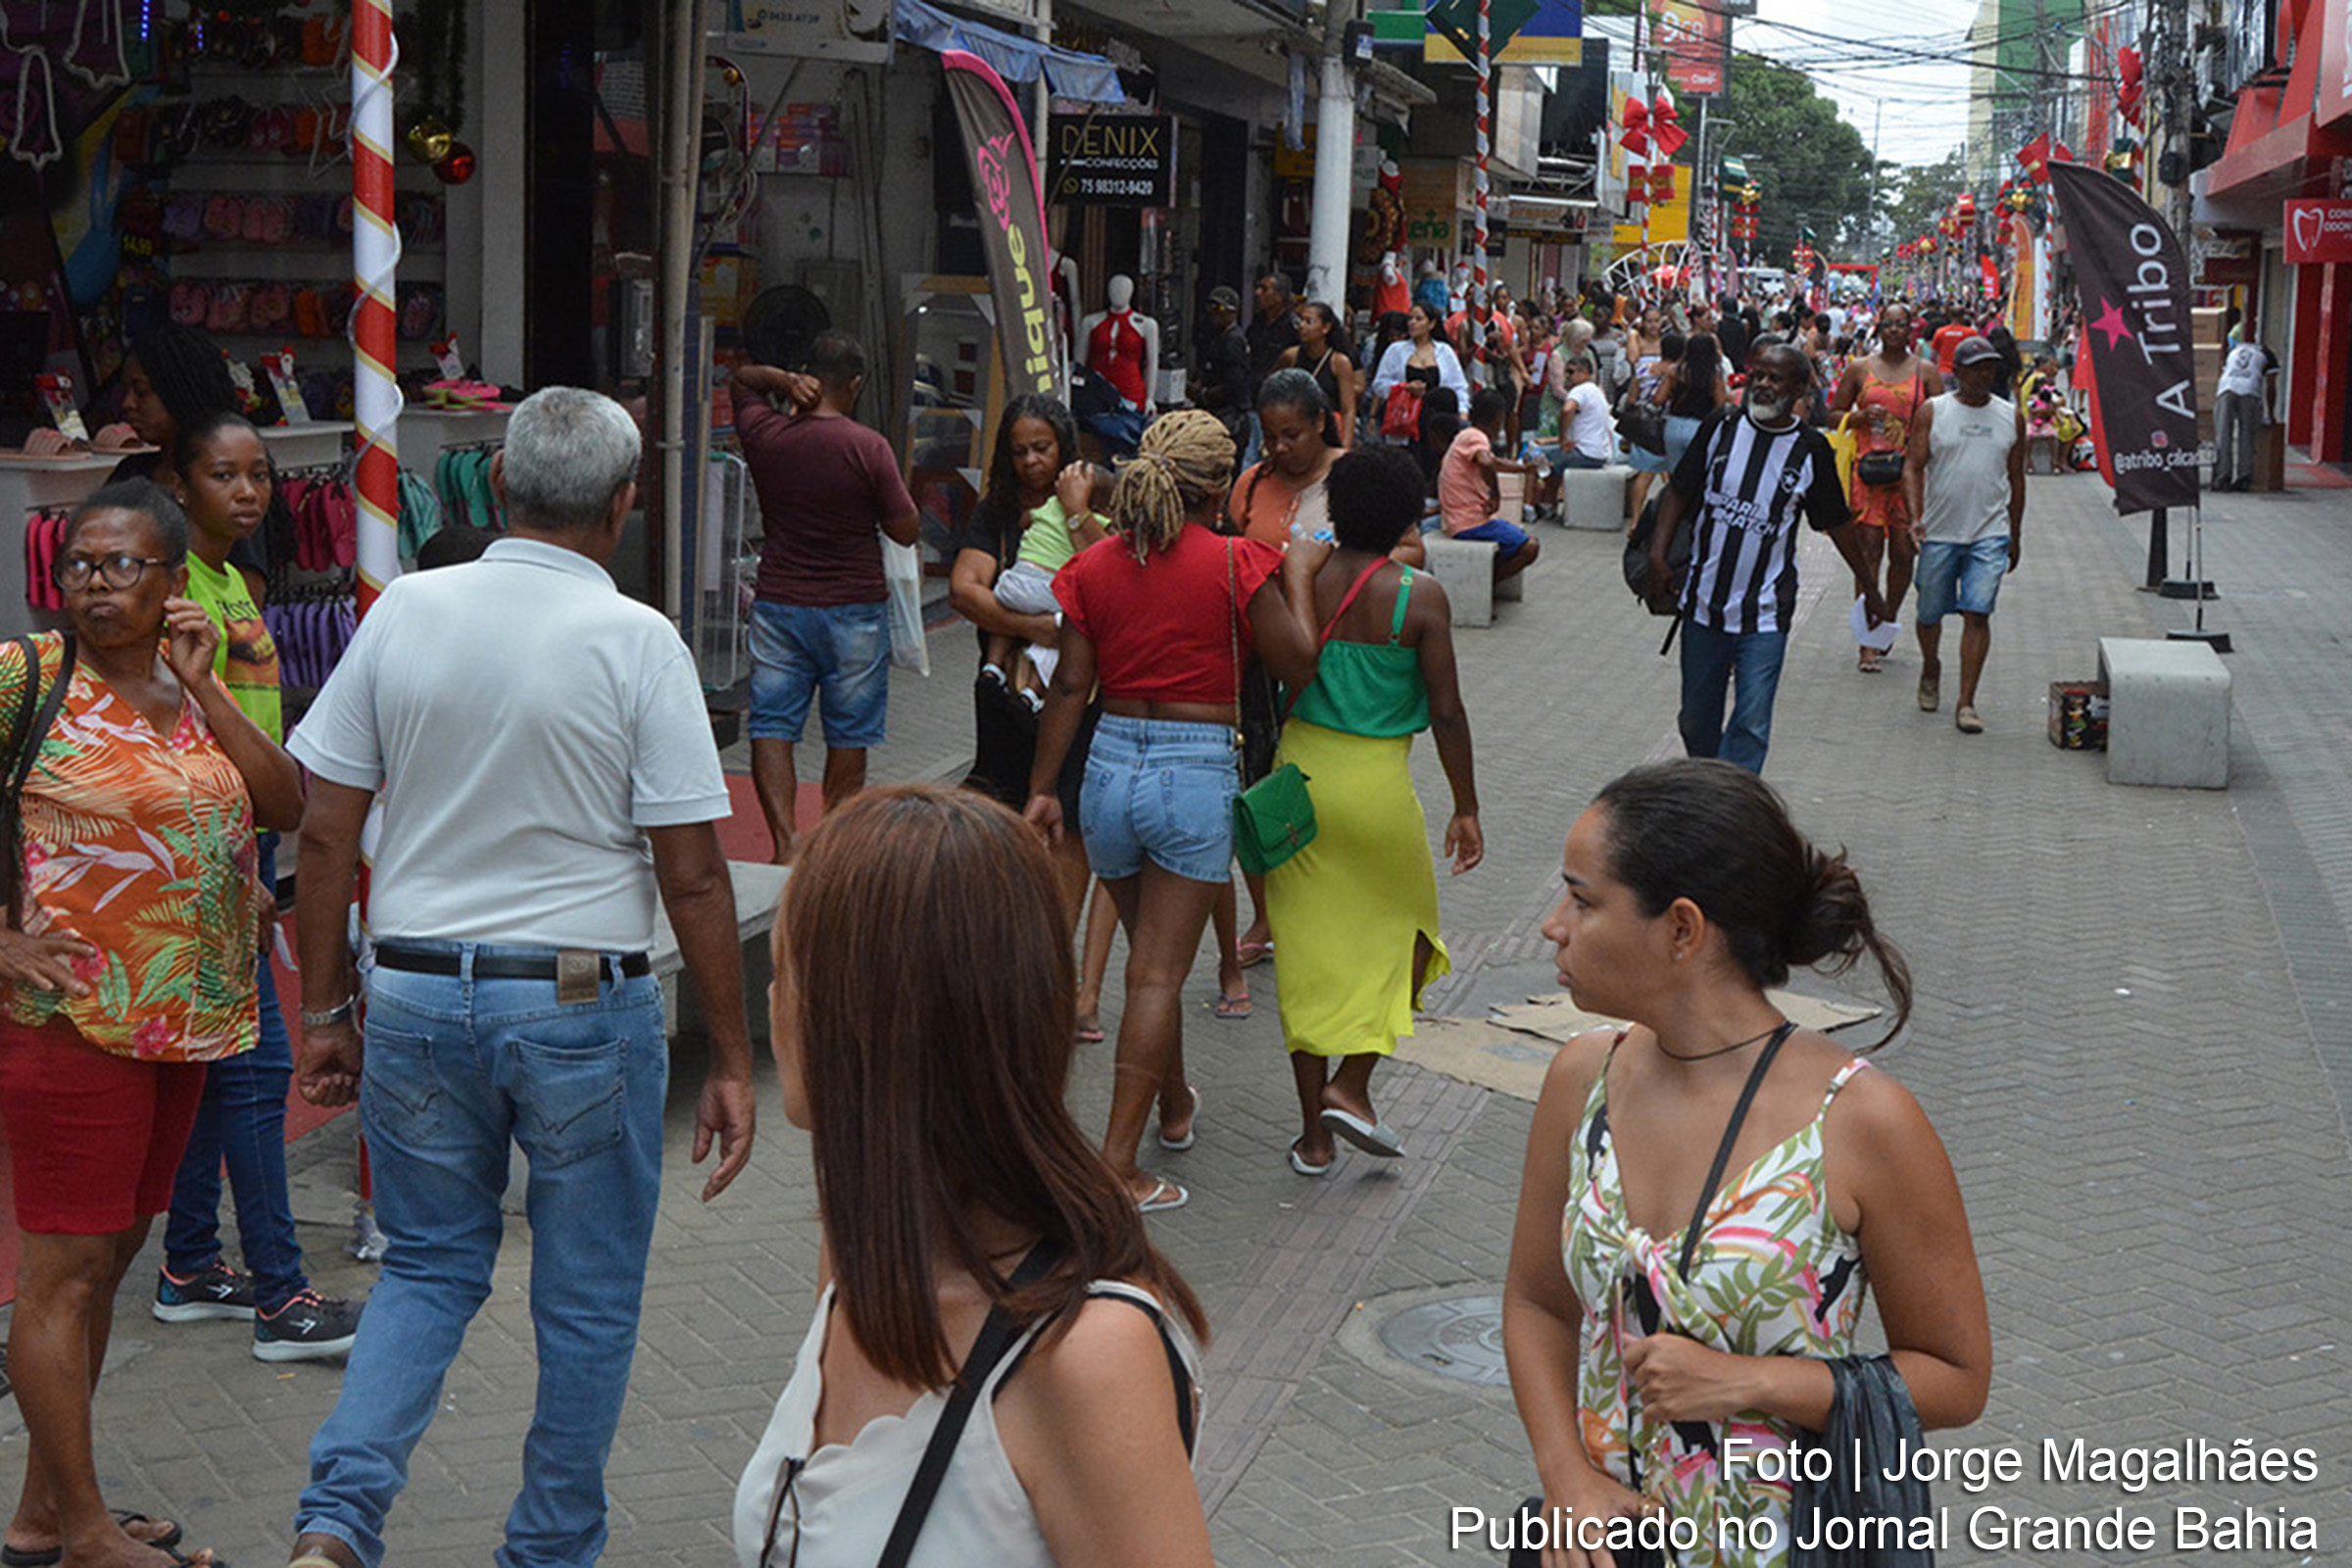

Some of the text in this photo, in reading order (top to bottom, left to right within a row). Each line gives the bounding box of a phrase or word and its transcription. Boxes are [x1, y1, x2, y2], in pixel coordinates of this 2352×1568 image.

[1061, 124, 1158, 157] DENIX
[1080, 178, 1094, 194] 75
[2127, 222, 2196, 419] A Tribo
[1721, 510, 1777, 536] MATCH
